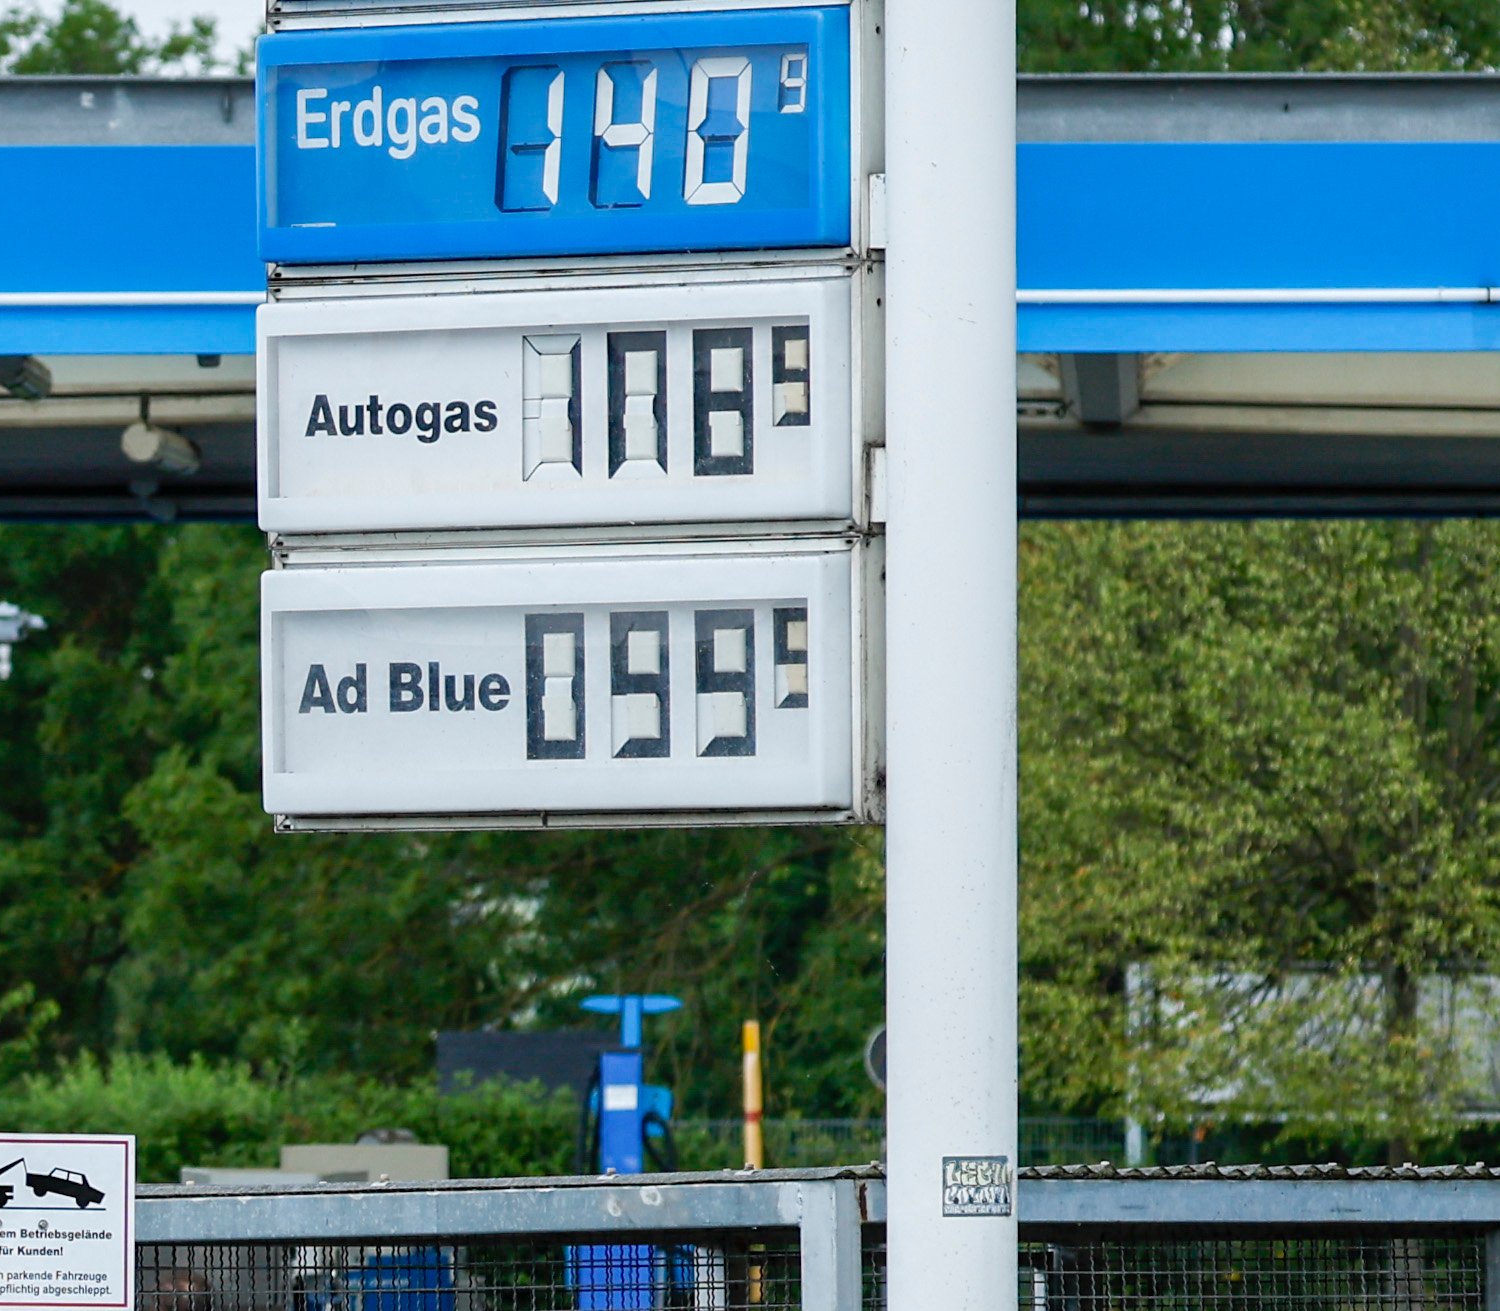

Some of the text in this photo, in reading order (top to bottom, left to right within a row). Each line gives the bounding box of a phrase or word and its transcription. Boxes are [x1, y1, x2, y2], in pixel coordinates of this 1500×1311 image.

[297, 86, 481, 159] Erdgas
[305, 394, 498, 444] Autogas
[298, 663, 368, 714] Ad
[389, 661, 511, 713] Blue
[20, 1229, 112, 1241] Betriebsgelände
[17, 1246, 63, 1256] Kunden!
[6, 1271, 53, 1282] parkende
[55, 1271, 108, 1282] Fahrzeuge
[42, 1284, 112, 1296] abgeschleppt.
